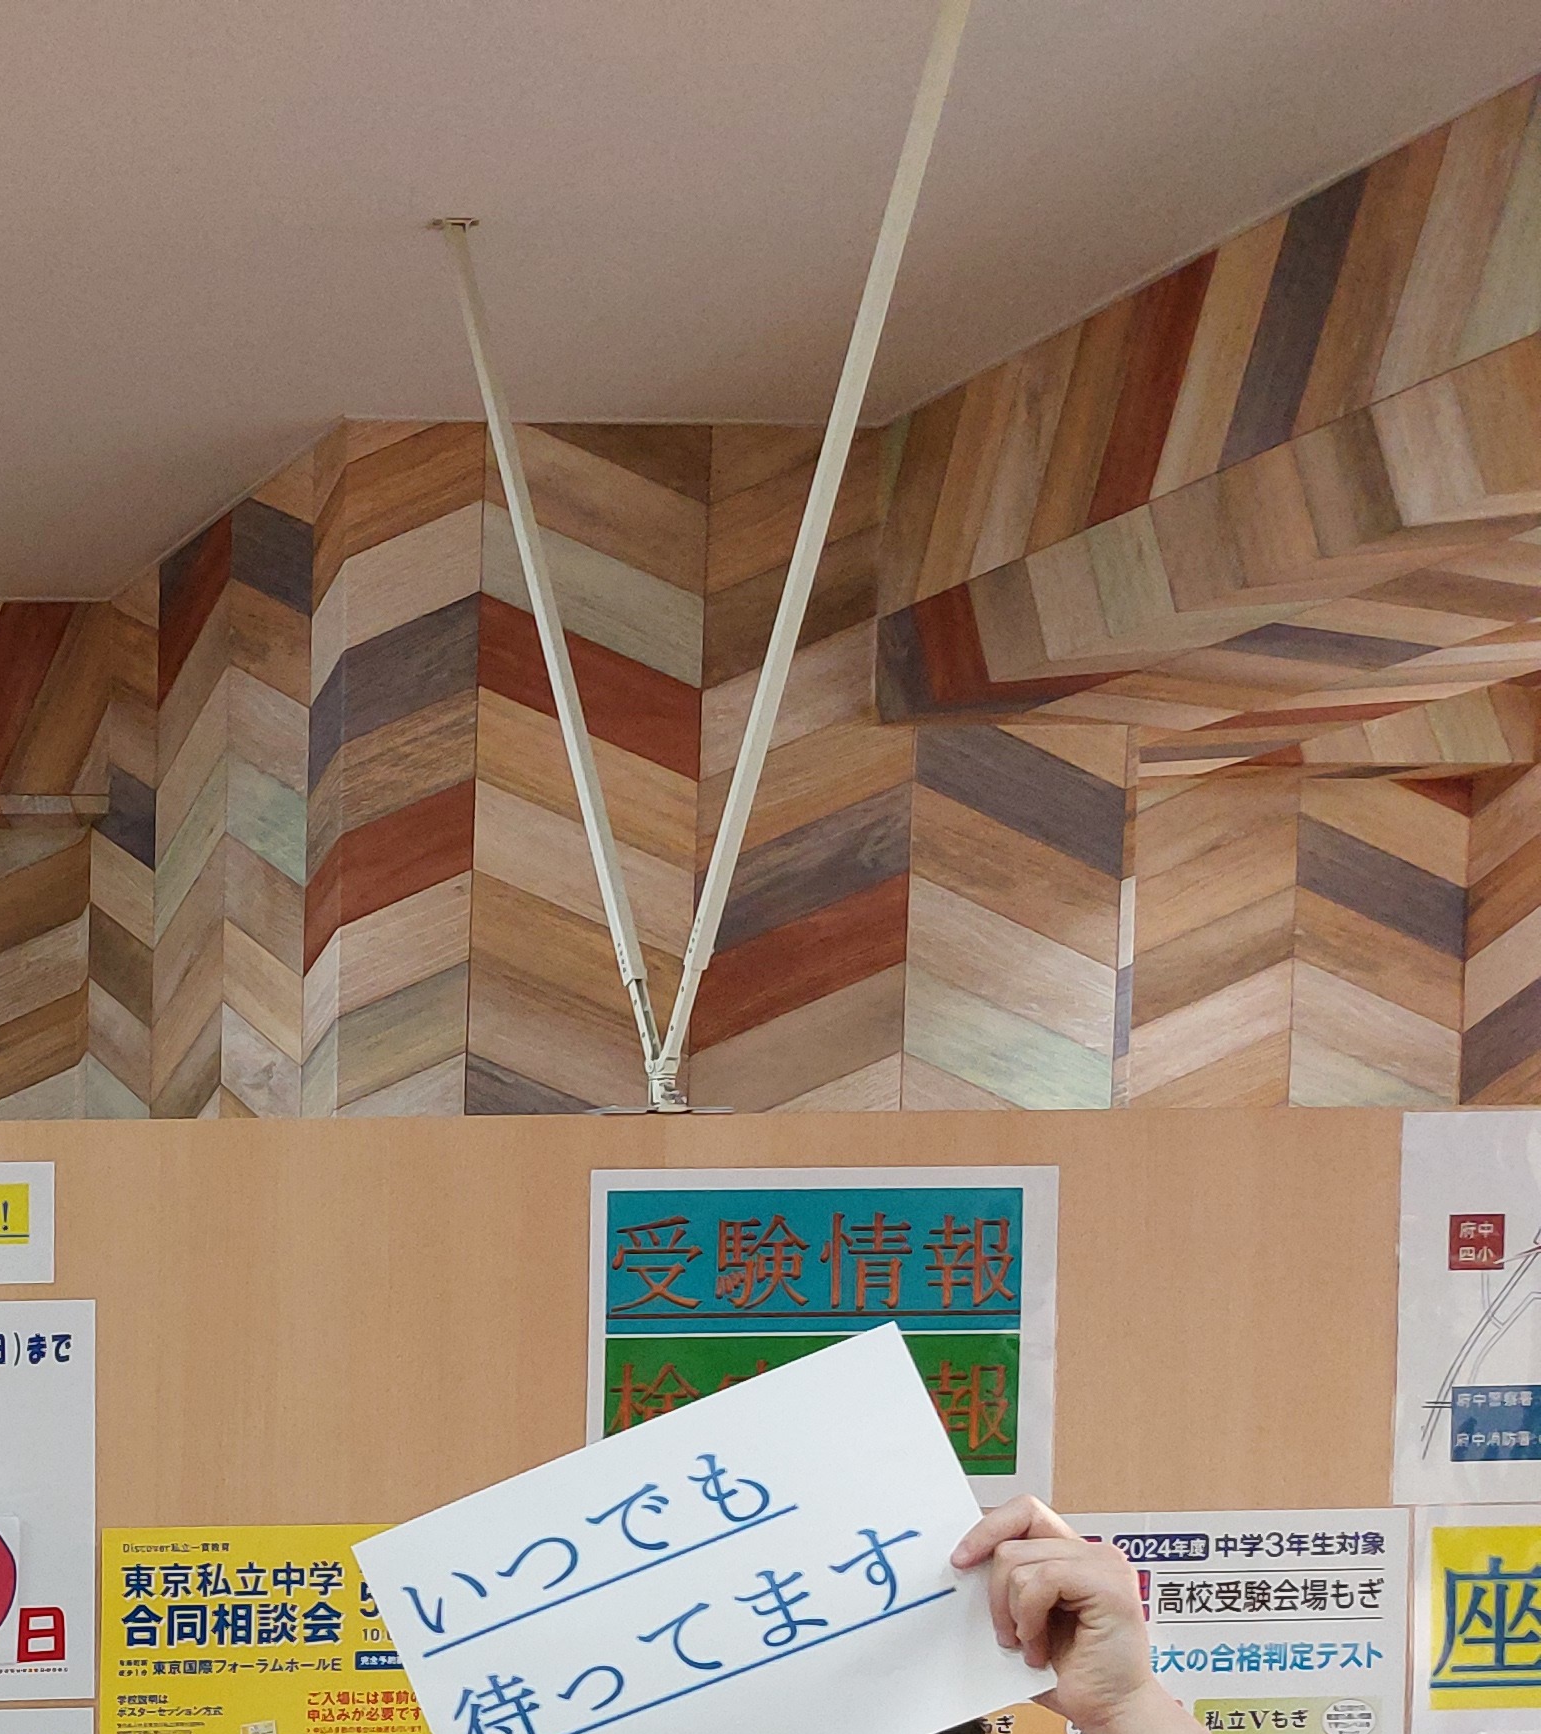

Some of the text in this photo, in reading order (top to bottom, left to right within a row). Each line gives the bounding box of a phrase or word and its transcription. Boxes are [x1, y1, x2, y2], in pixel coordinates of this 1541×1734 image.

[610, 1211, 1018, 1313] 受験情報
[607, 1360, 1014, 1451] 検報
[402, 1453, 770, 1636] いつでも
[1118, 1531, 1386, 1559] 2024年度 中学3年生対象
[120, 1560, 344, 1600] 東京私立中学
[1156, 1578, 1385, 1615] 高校受験会場もぎ
[120, 1602, 344, 1648] 合同相談会
[1429, 1555, 1541, 1679] 座
[1205, 1709, 1309, 1731] 私立Vもぎ
